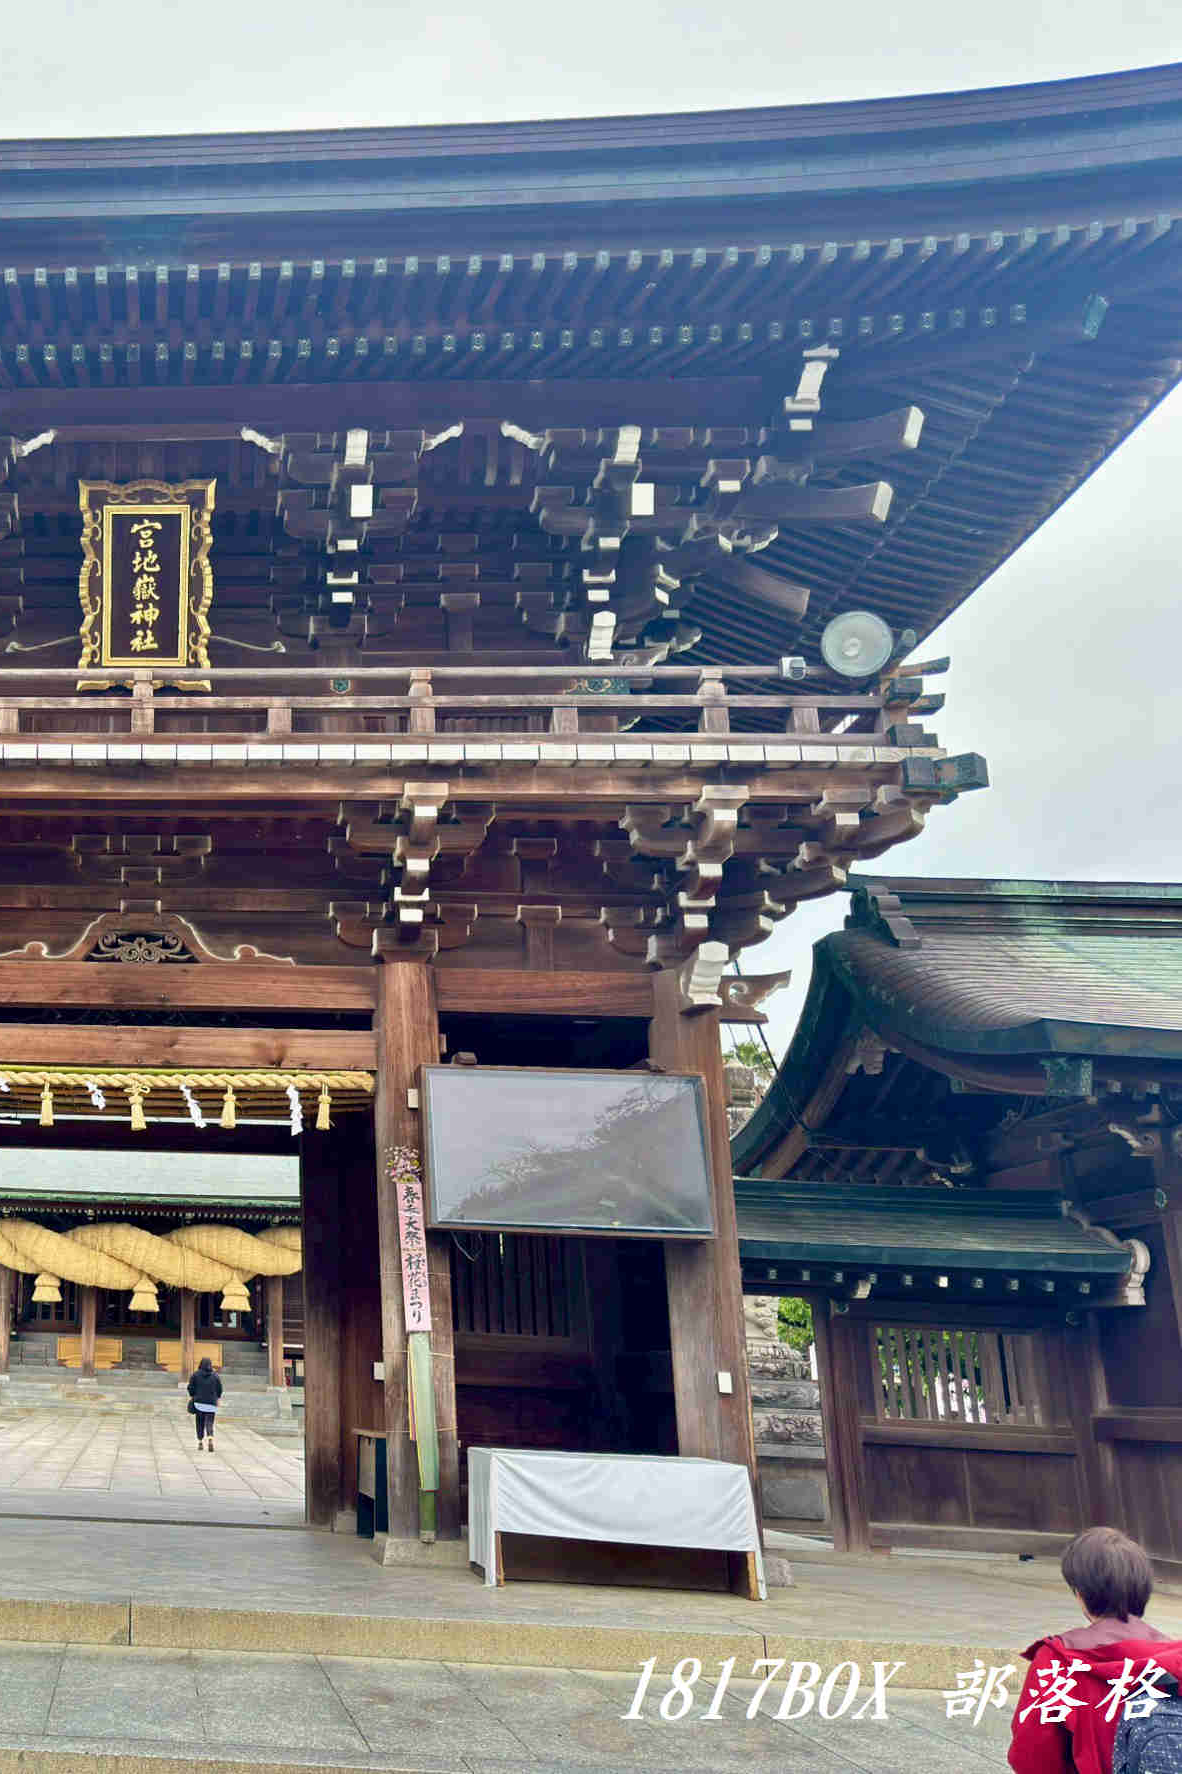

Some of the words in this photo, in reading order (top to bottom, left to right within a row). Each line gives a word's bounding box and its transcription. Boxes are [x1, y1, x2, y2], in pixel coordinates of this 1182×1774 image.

[130, 518, 163, 653] 宮地嶽神社
